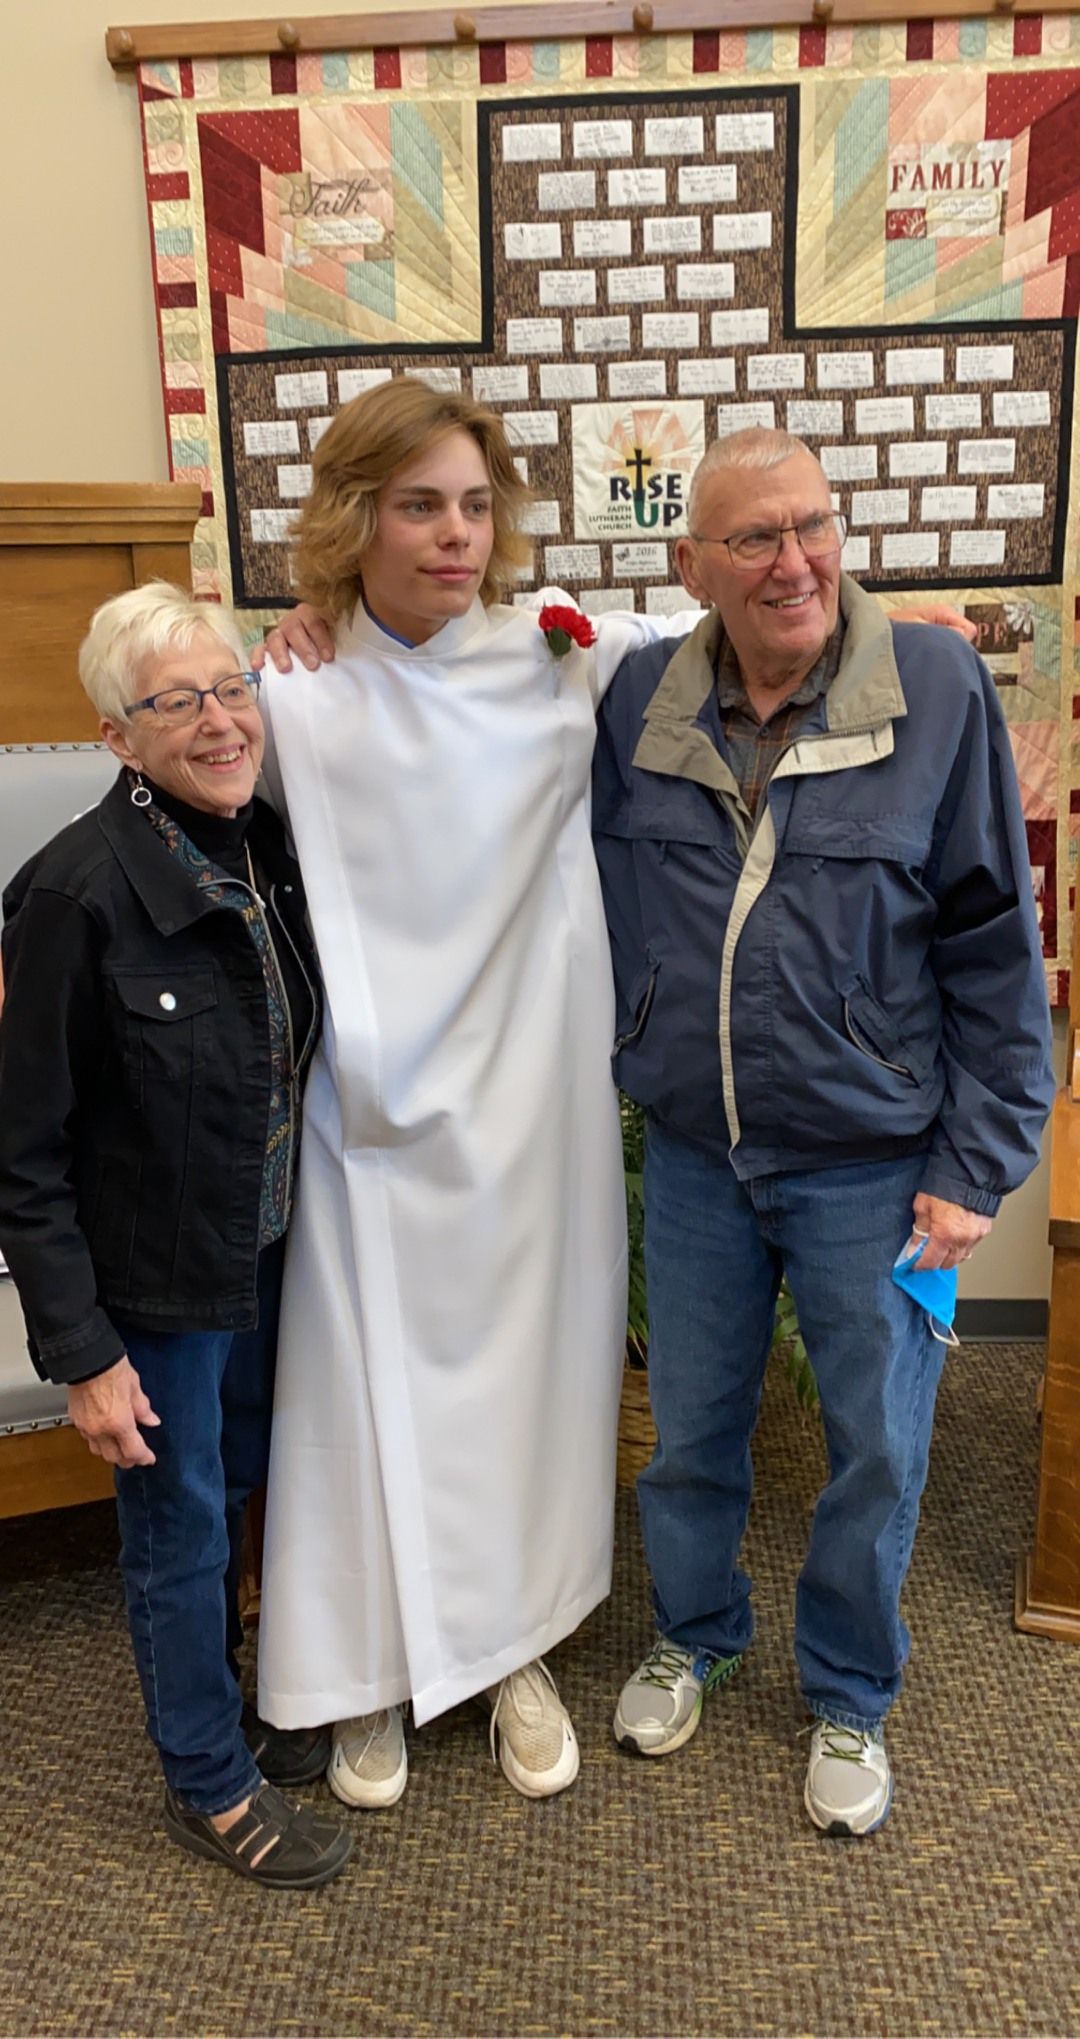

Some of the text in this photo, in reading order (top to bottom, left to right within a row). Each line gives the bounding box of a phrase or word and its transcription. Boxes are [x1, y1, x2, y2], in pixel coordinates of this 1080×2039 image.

[890, 159, 1006, 192] FAMILY
[289, 178, 379, 218] Faith
[609, 467, 683, 501] RISE
[588, 514, 632, 523] LUTHERAN
[607, 505, 632, 513] FAITH
[598, 522, 632, 531] CHURCH
[635, 545, 658, 557] 2016
[976, 621, 1009, 648] PE
